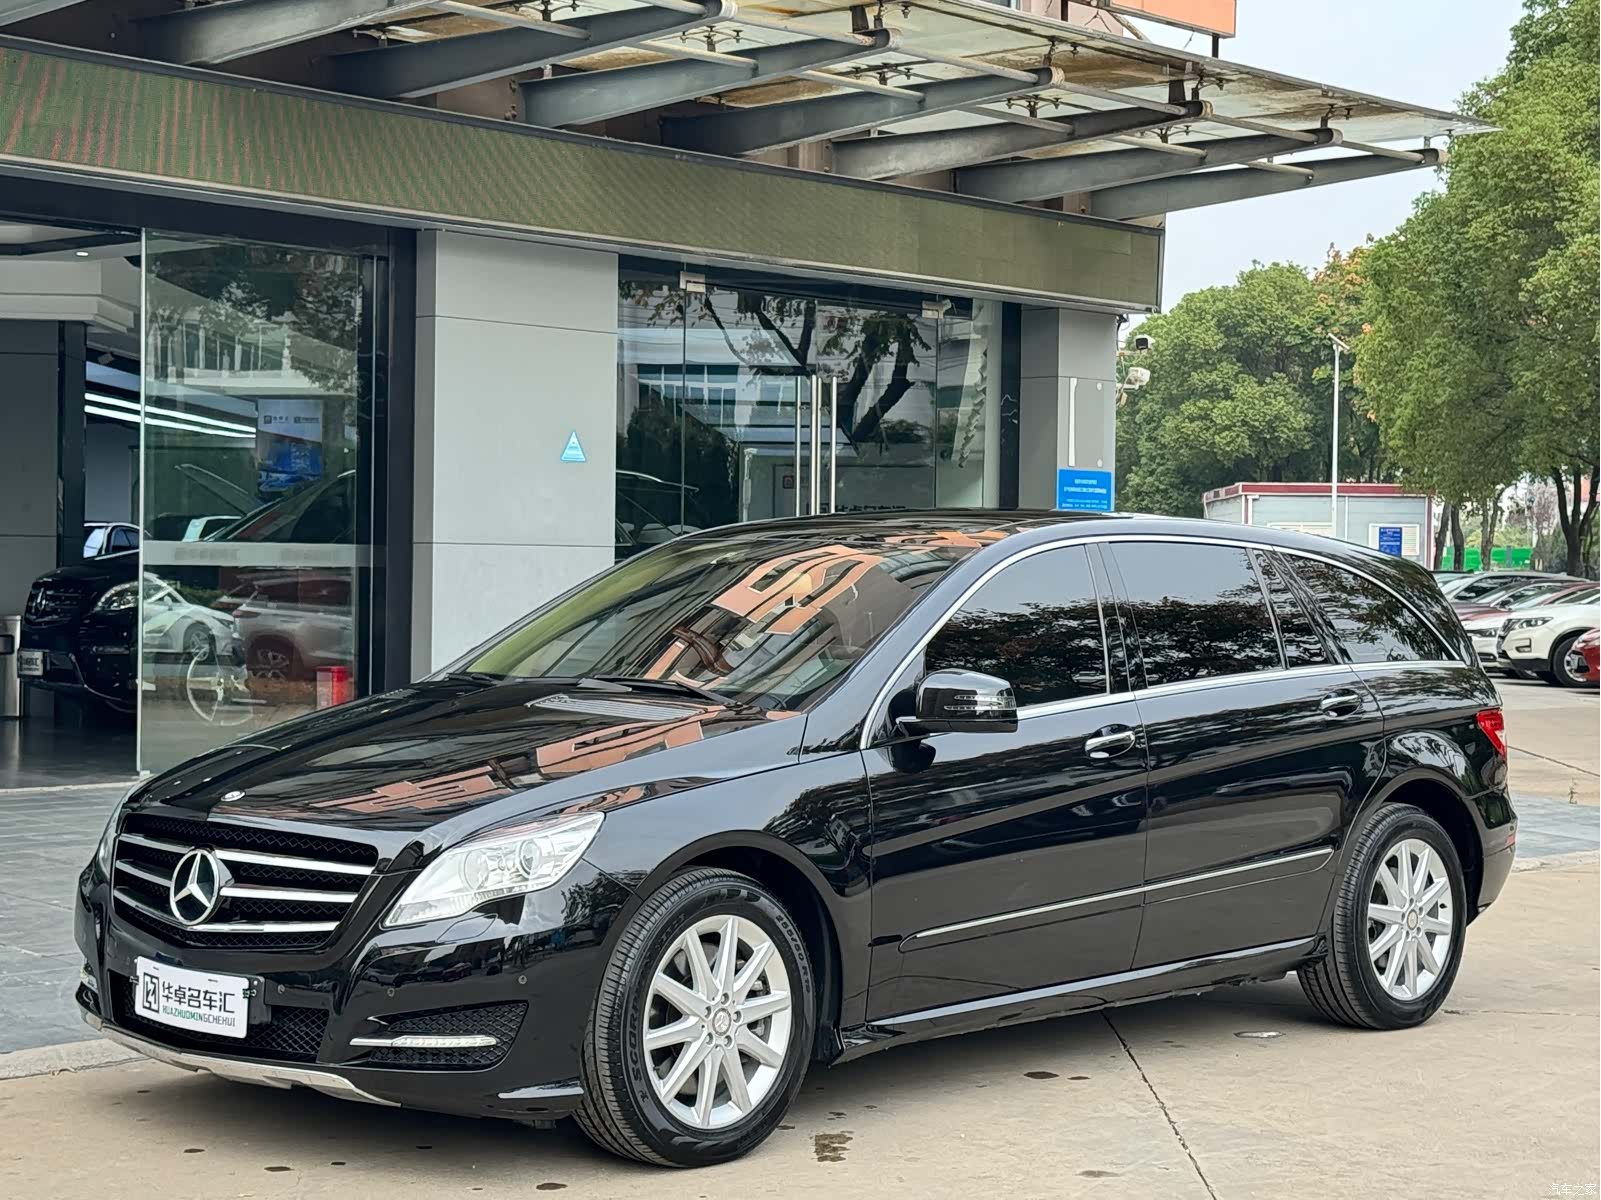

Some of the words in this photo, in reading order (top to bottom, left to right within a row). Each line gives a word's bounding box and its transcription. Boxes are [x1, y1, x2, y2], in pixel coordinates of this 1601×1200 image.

[162, 980, 235, 1013] 华卓名车汇
